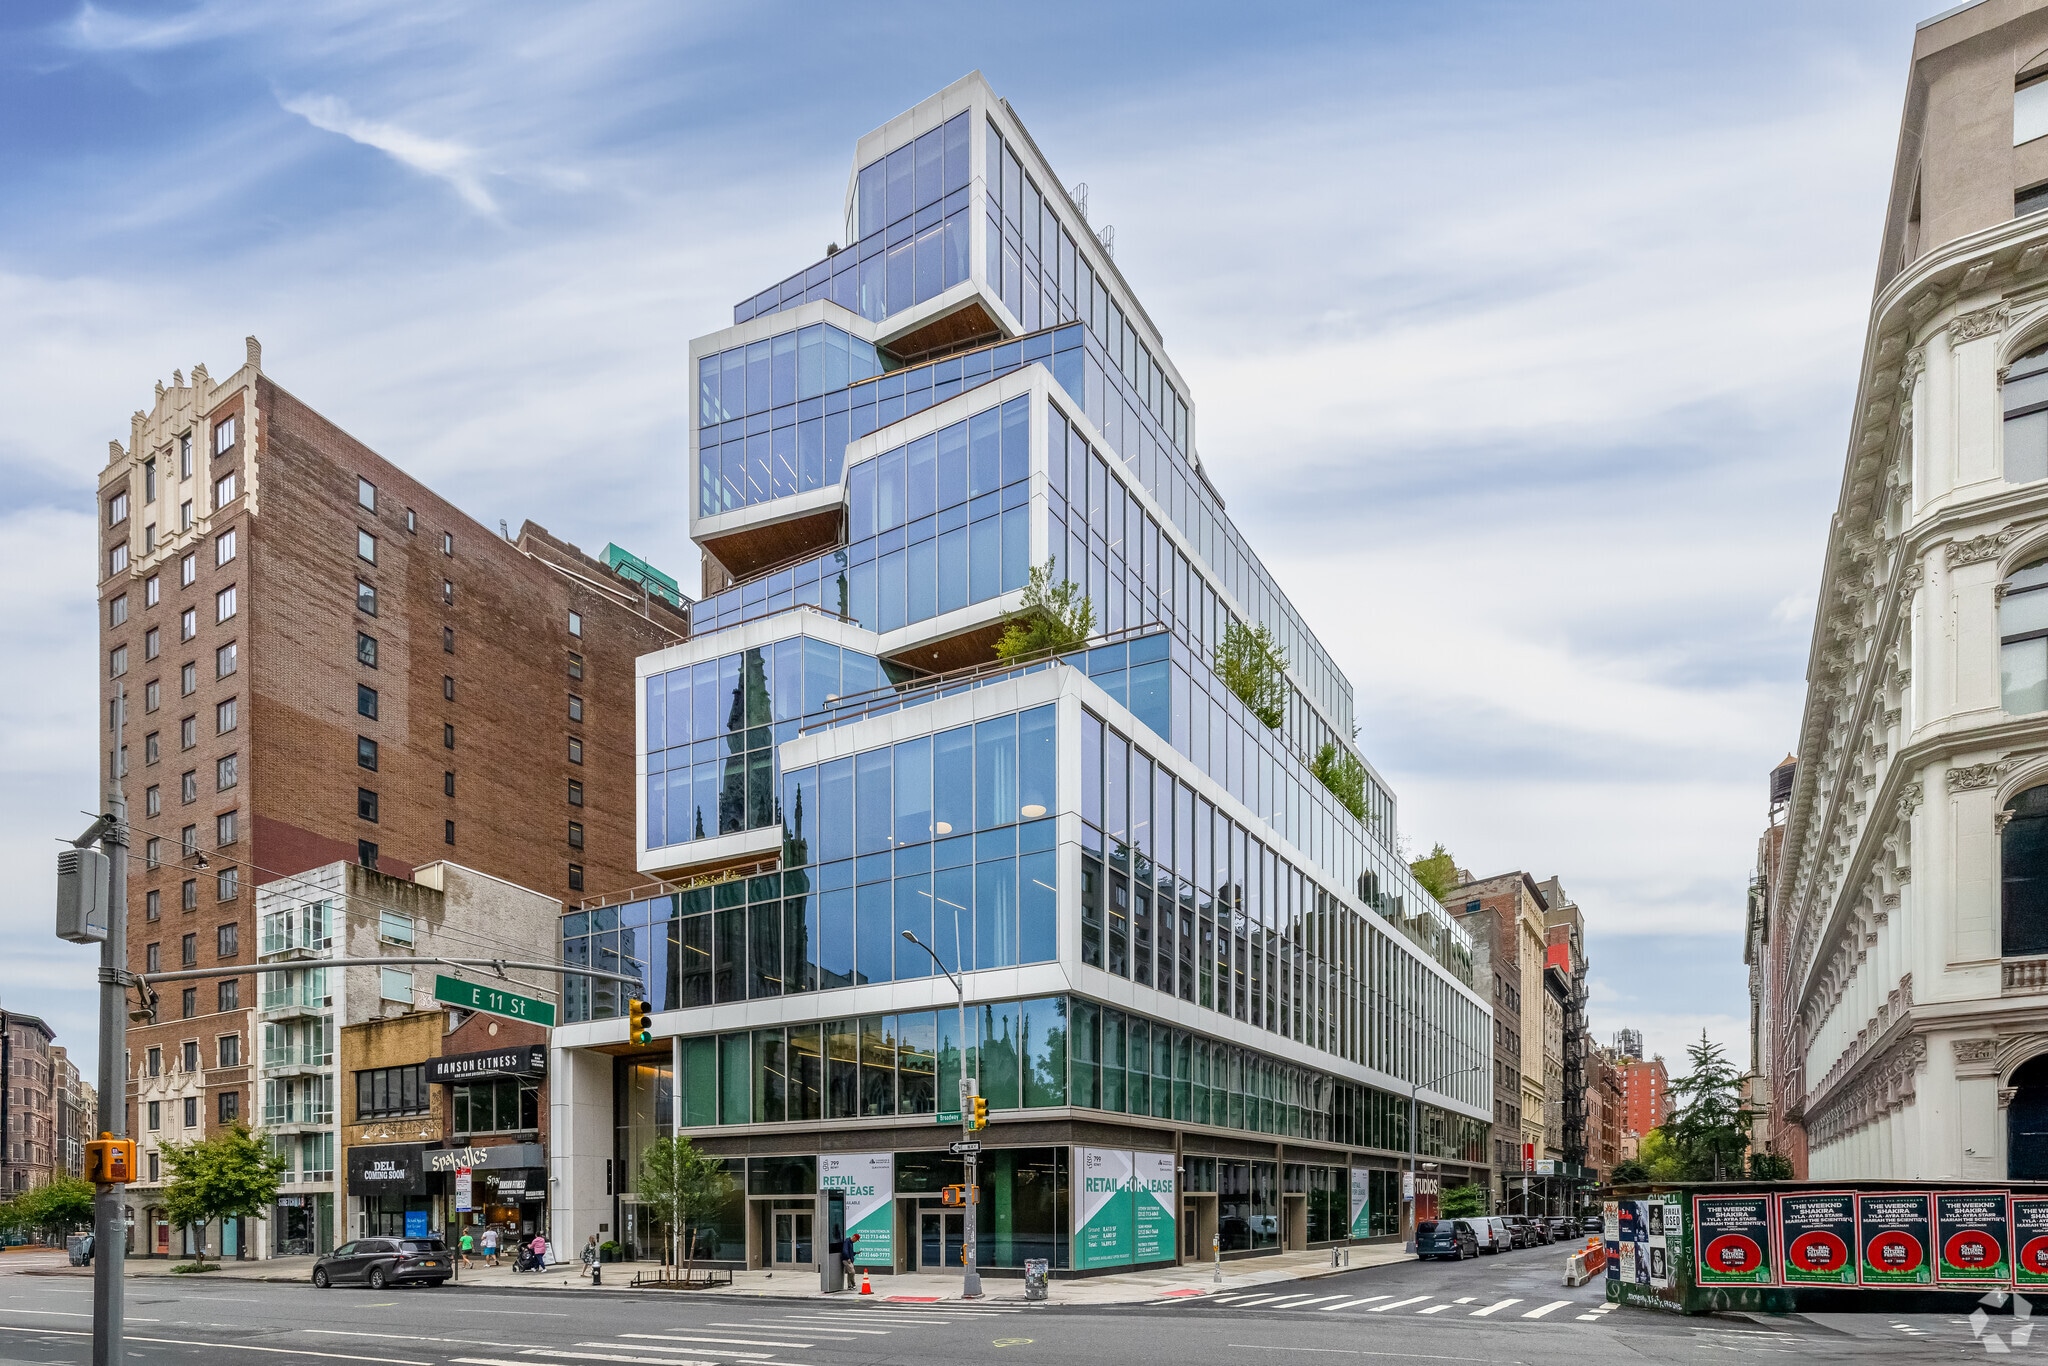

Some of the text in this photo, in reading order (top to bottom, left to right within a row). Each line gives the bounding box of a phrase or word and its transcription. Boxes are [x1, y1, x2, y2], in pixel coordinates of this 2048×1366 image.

[472, 988, 526, 1016] E 11 St
[437, 1060, 474, 1074] HANSON
[478, 1055, 517, 1070] FITNESS
[432, 1146, 488, 1172] Spabelles
[374, 1161, 395, 1171] DELI
[364, 1169, 405, 1180] COMING SOON
[823, 1176, 856, 1186] RETAIL
[846, 1186, 874, 1196] LEASE
[1086, 1177, 1172, 1192] RETAIL FOR LEASE
[1415, 1178, 1437, 1194] TUDIOS
[1665, 1216, 1680, 1226] OSED
